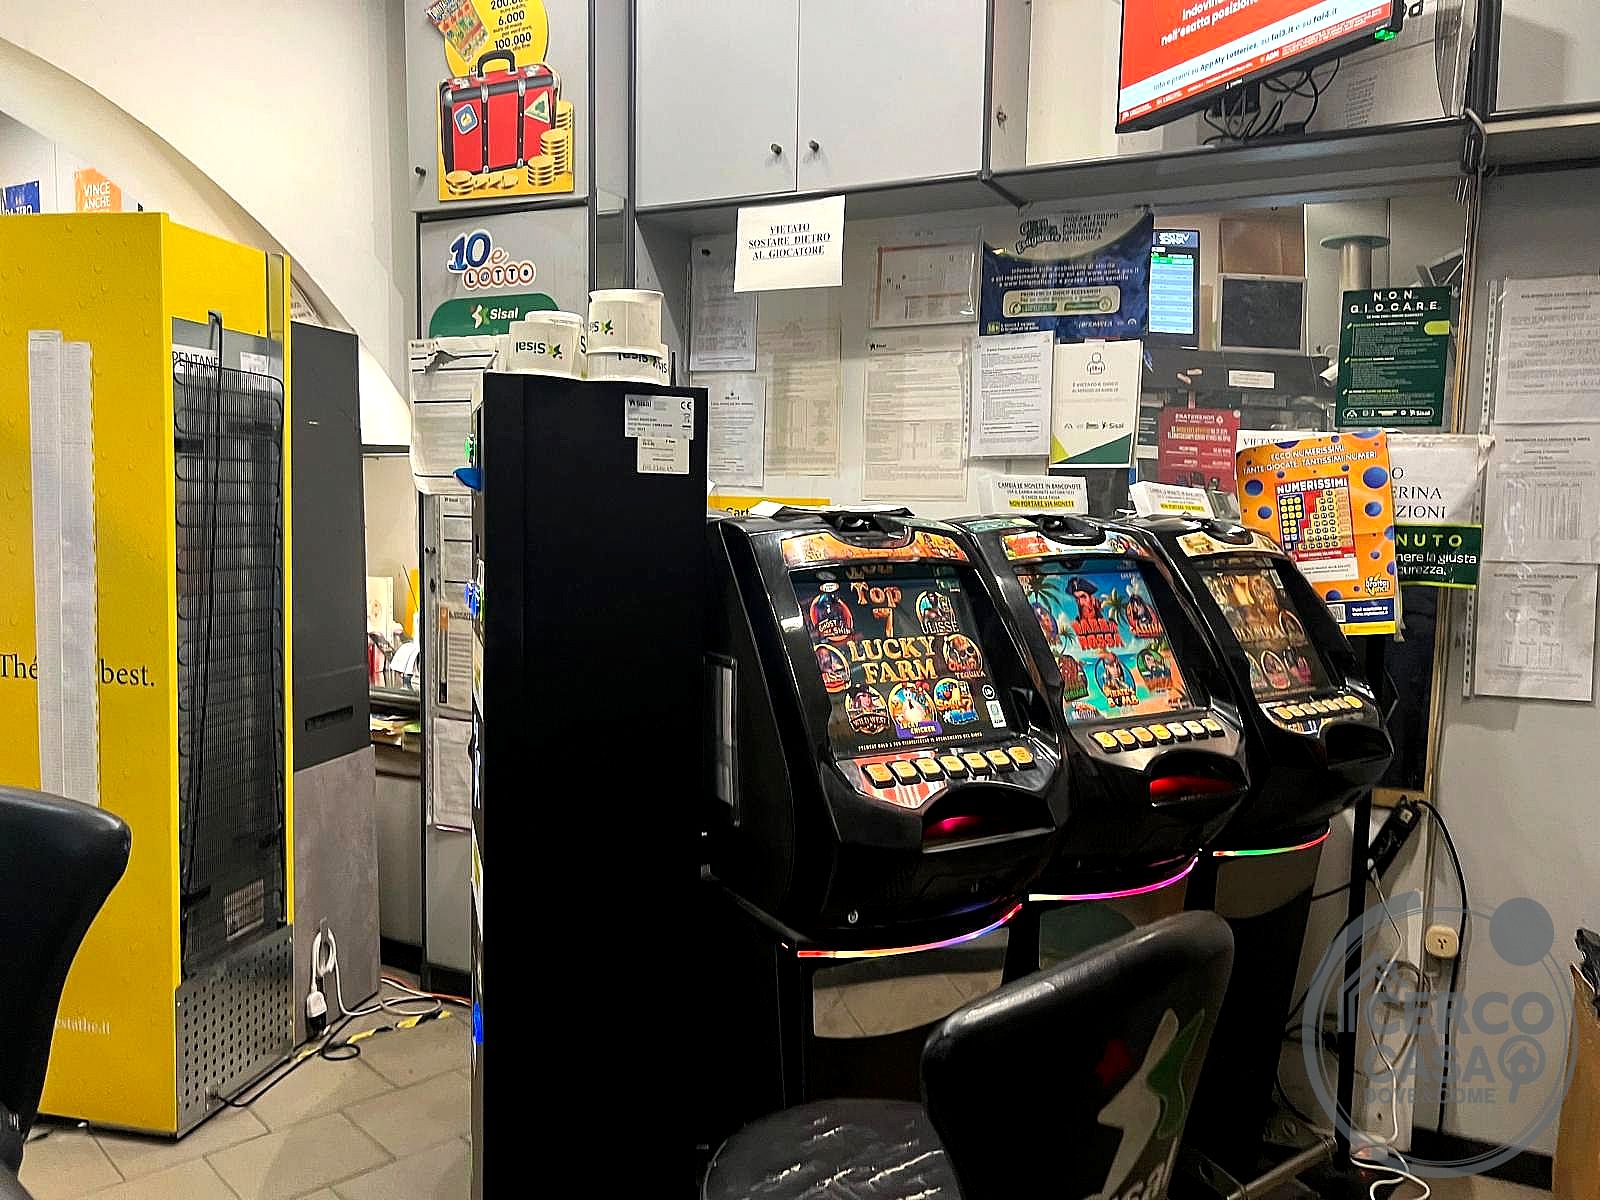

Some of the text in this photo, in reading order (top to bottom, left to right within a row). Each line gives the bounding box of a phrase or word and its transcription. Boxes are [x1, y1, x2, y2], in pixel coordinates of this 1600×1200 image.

[491, 0, 523, 10] 200.
[498, 10, 525, 26] 6.000
[1160, 15, 1211, 46] nell'esatta
[495, 32, 532, 51] 100.000
[82, 181, 111, 197] VINCE
[83, 196, 111, 209] ANCHE
[769, 223, 810, 235] VIETATO
[748, 232, 831, 250] SOSTARE DIETRO
[448, 232, 508, 272] 10 e
[752, 246, 825, 261] AL GIOCATORE
[463, 263, 534, 289] LOTTO
[1374, 289, 1413, 301] NON
[489, 307, 519, 321] Sisal
[1350, 301, 1438, 313] GIOCARE
[515, 341, 546, 354] Sisal
[1269, 451, 1293, 462] ECCO
[1346, 450, 1377, 461] NUMERI
[1276, 477, 1348, 495] NUMERISSIMI
[1395, 504, 1446, 519] ZIONI
[1396, 533, 1463, 548] NUTO
[1396, 553, 1424, 563] nere
[1437, 553, 1477, 566] giusta
[849, 581, 902, 609] Top
[872, 607, 894, 639] 7
[920, 620, 961, 635] ULISSE
[846, 635, 937, 663] LUCKY
[100, 658, 155, 687] best.
[861, 657, 939, 685] FARM
[954, 670, 987, 680] TEQUILA
[1107, 696, 1140, 708] BOMB
